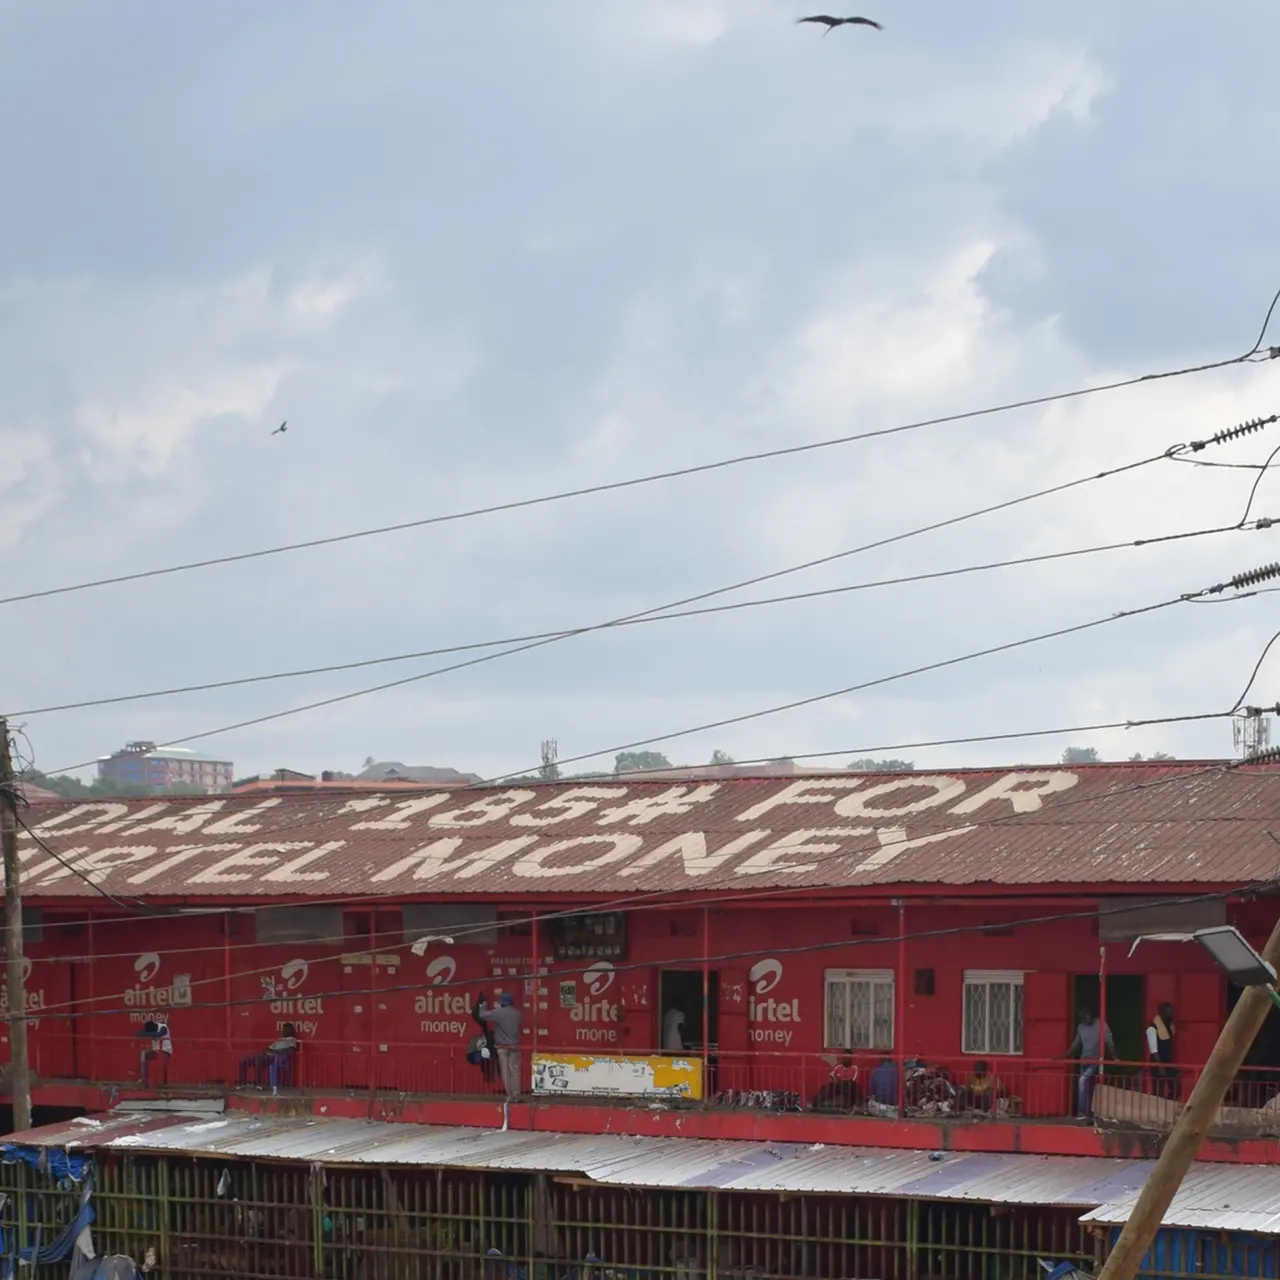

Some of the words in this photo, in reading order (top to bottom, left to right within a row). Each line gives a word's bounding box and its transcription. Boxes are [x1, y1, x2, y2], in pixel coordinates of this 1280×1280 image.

[17, 798, 283, 838] DIAL
[733, 771, 1080, 822] FOR
[370, 823, 980, 883] MONEY
[0, 989, 45, 1009] atel
[124, 985, 175, 1006] airtel
[270, 993, 324, 1014] airtel
[414, 990, 473, 1014] airtel
[570, 996, 618, 1022] airte
[748, 996, 801, 1022] irtel
[420, 1020, 467, 1037] money
[576, 1026, 617, 1042] mone
